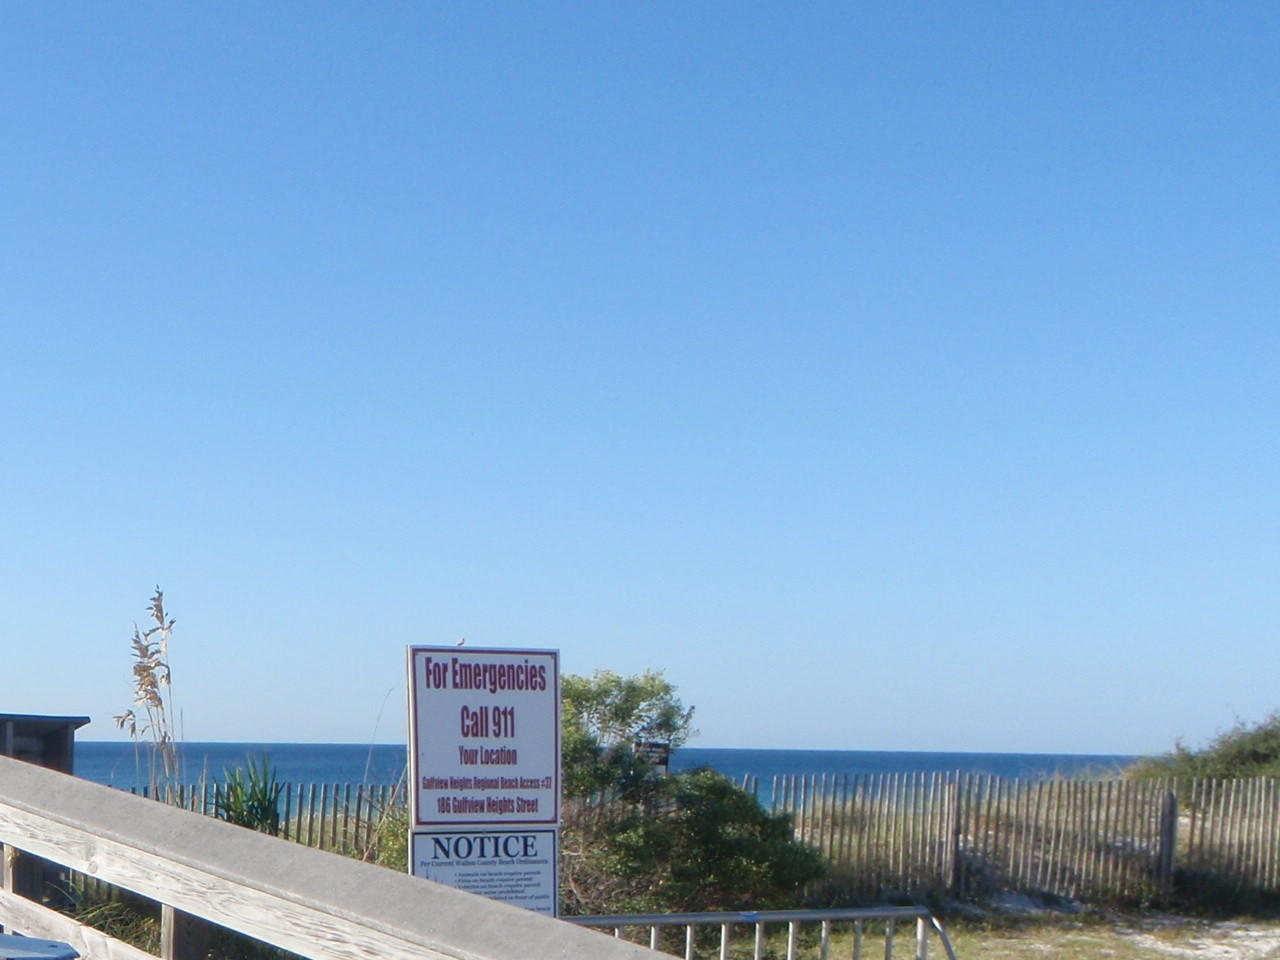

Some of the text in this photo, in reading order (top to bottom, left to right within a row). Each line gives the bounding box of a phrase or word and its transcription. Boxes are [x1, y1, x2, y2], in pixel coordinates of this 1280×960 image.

[425, 657, 546, 693] For Emergencies
[461, 706, 514, 738] Call 911
[459, 746, 517, 765] Your Location
[437, 797, 538, 814] 186 Gulfview Heights Street
[432, 836, 537, 859] NOTICE
